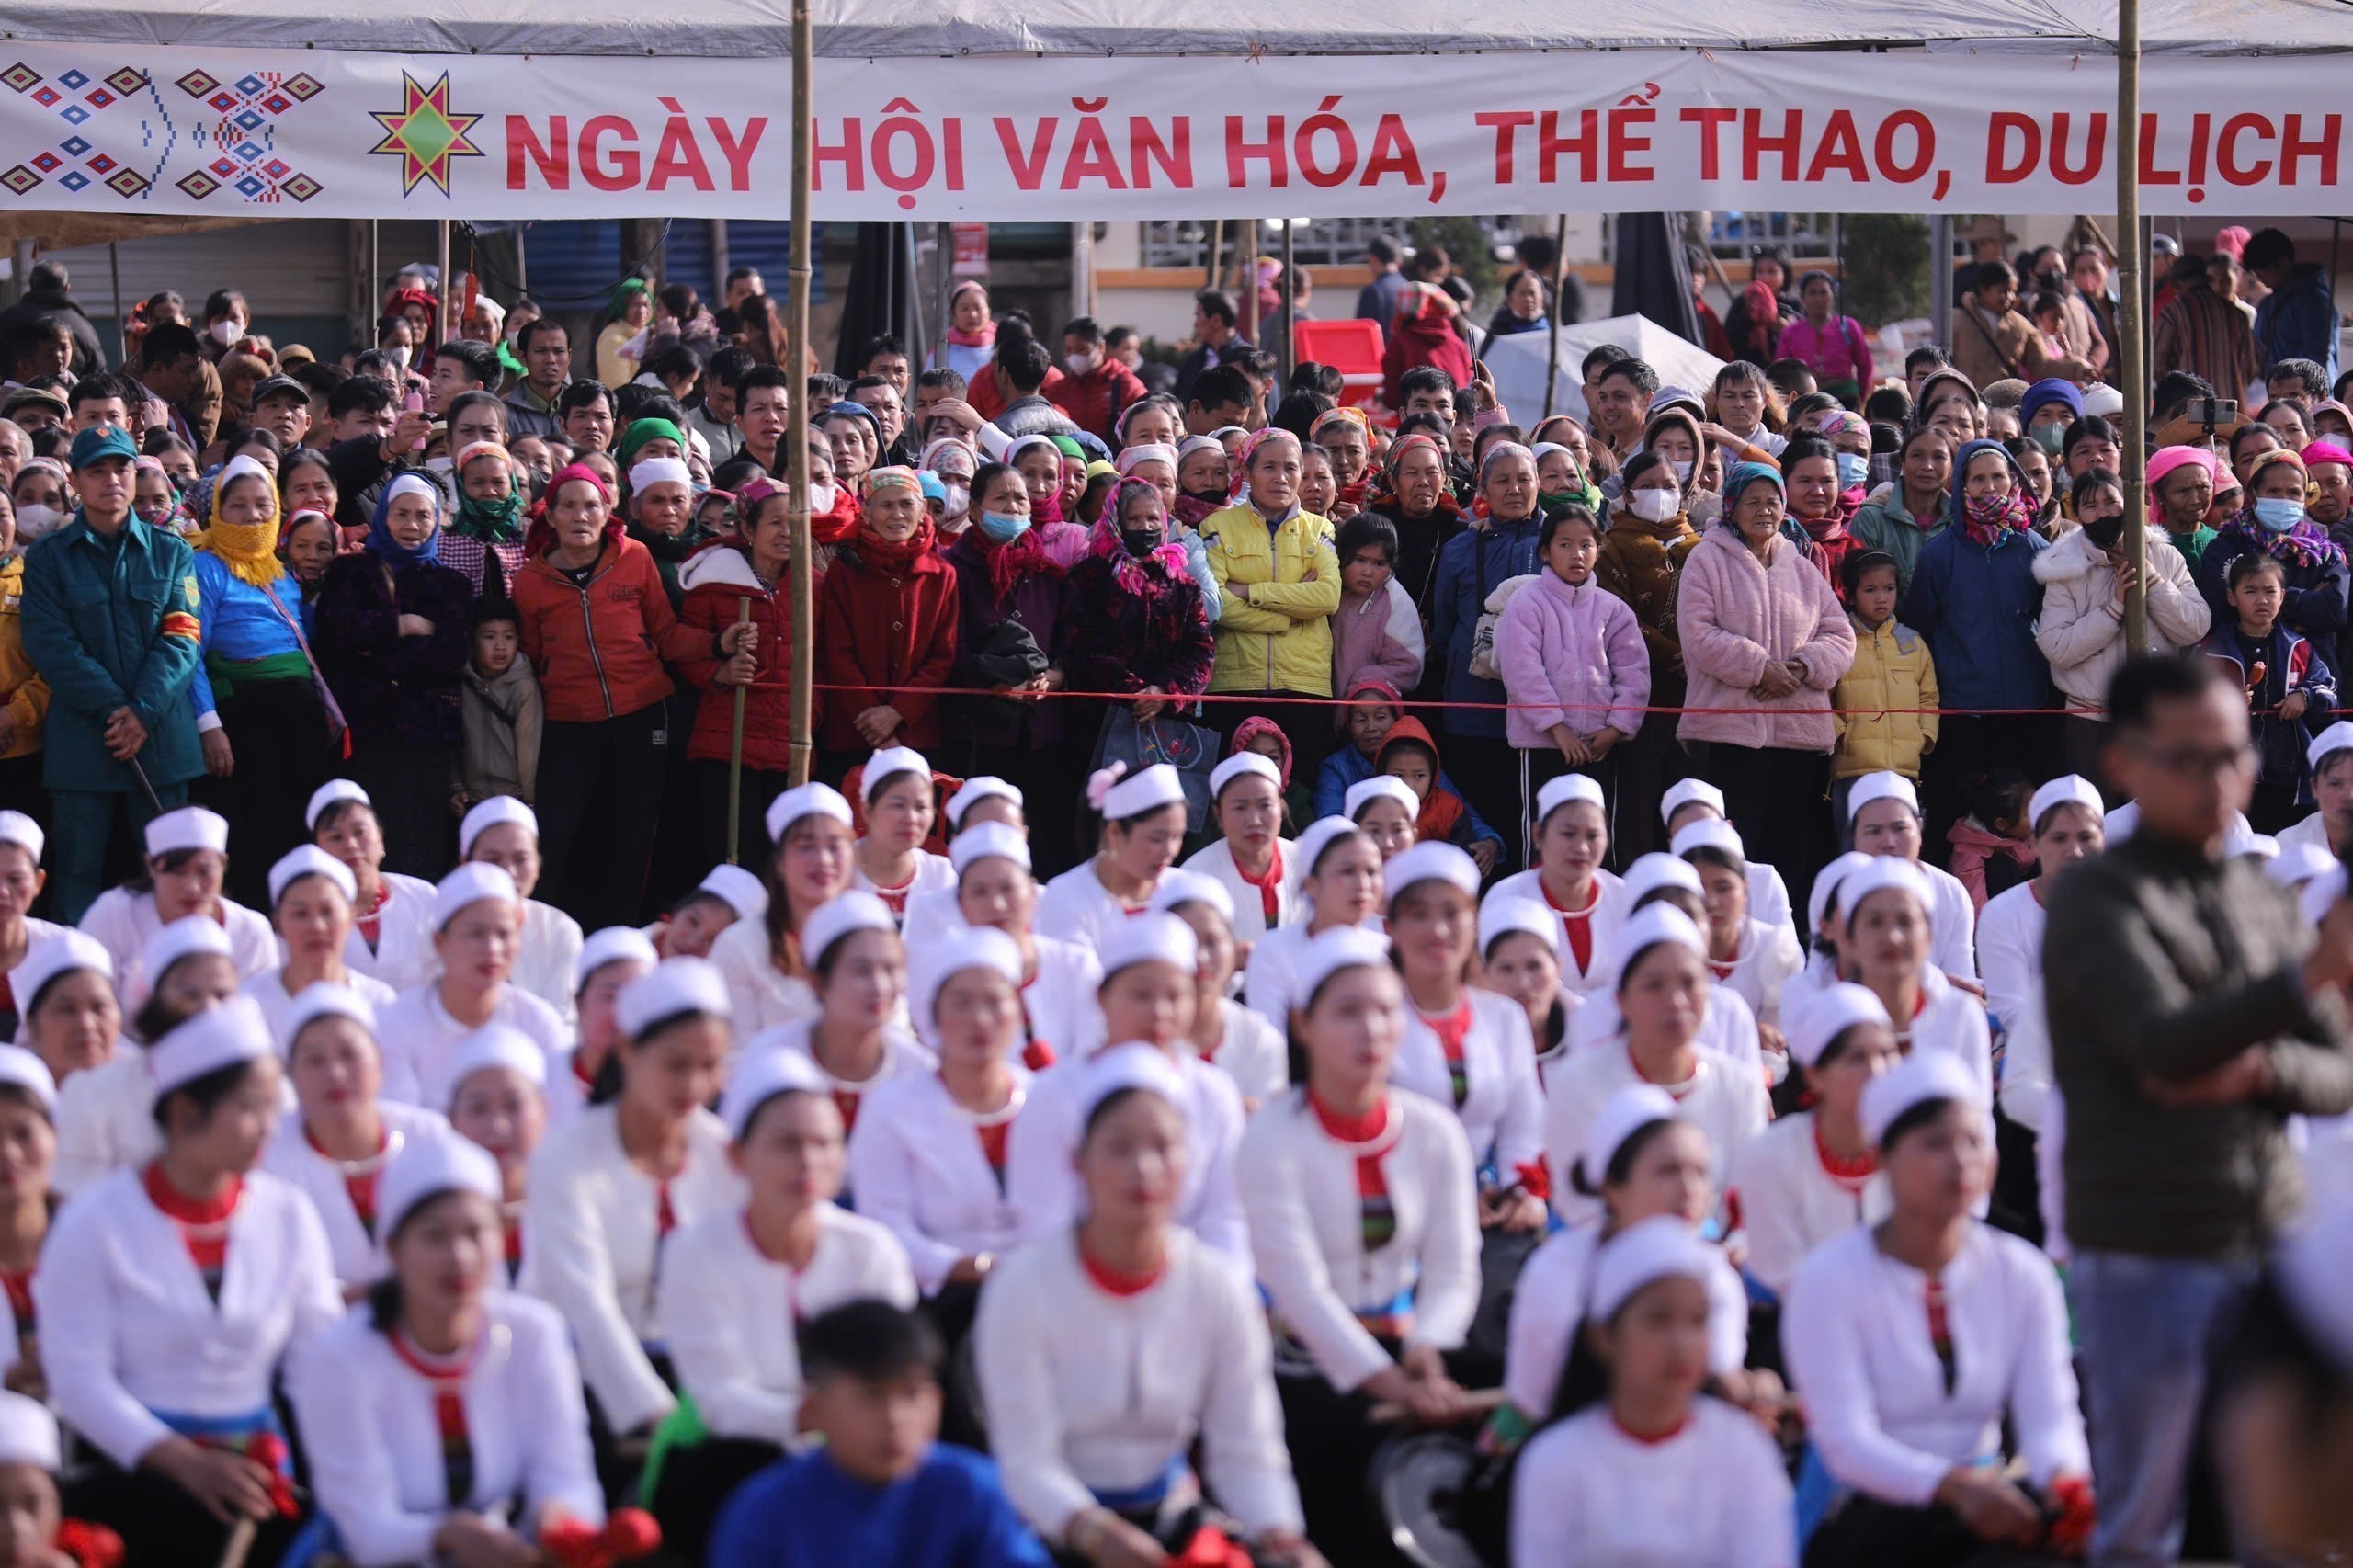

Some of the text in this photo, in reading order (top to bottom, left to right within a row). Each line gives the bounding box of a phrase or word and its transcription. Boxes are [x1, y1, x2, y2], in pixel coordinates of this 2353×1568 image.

[505, 82, 2342, 210] NGÀY HỘI VĂN HÓA, THỂ THAO, DU LỊCH
